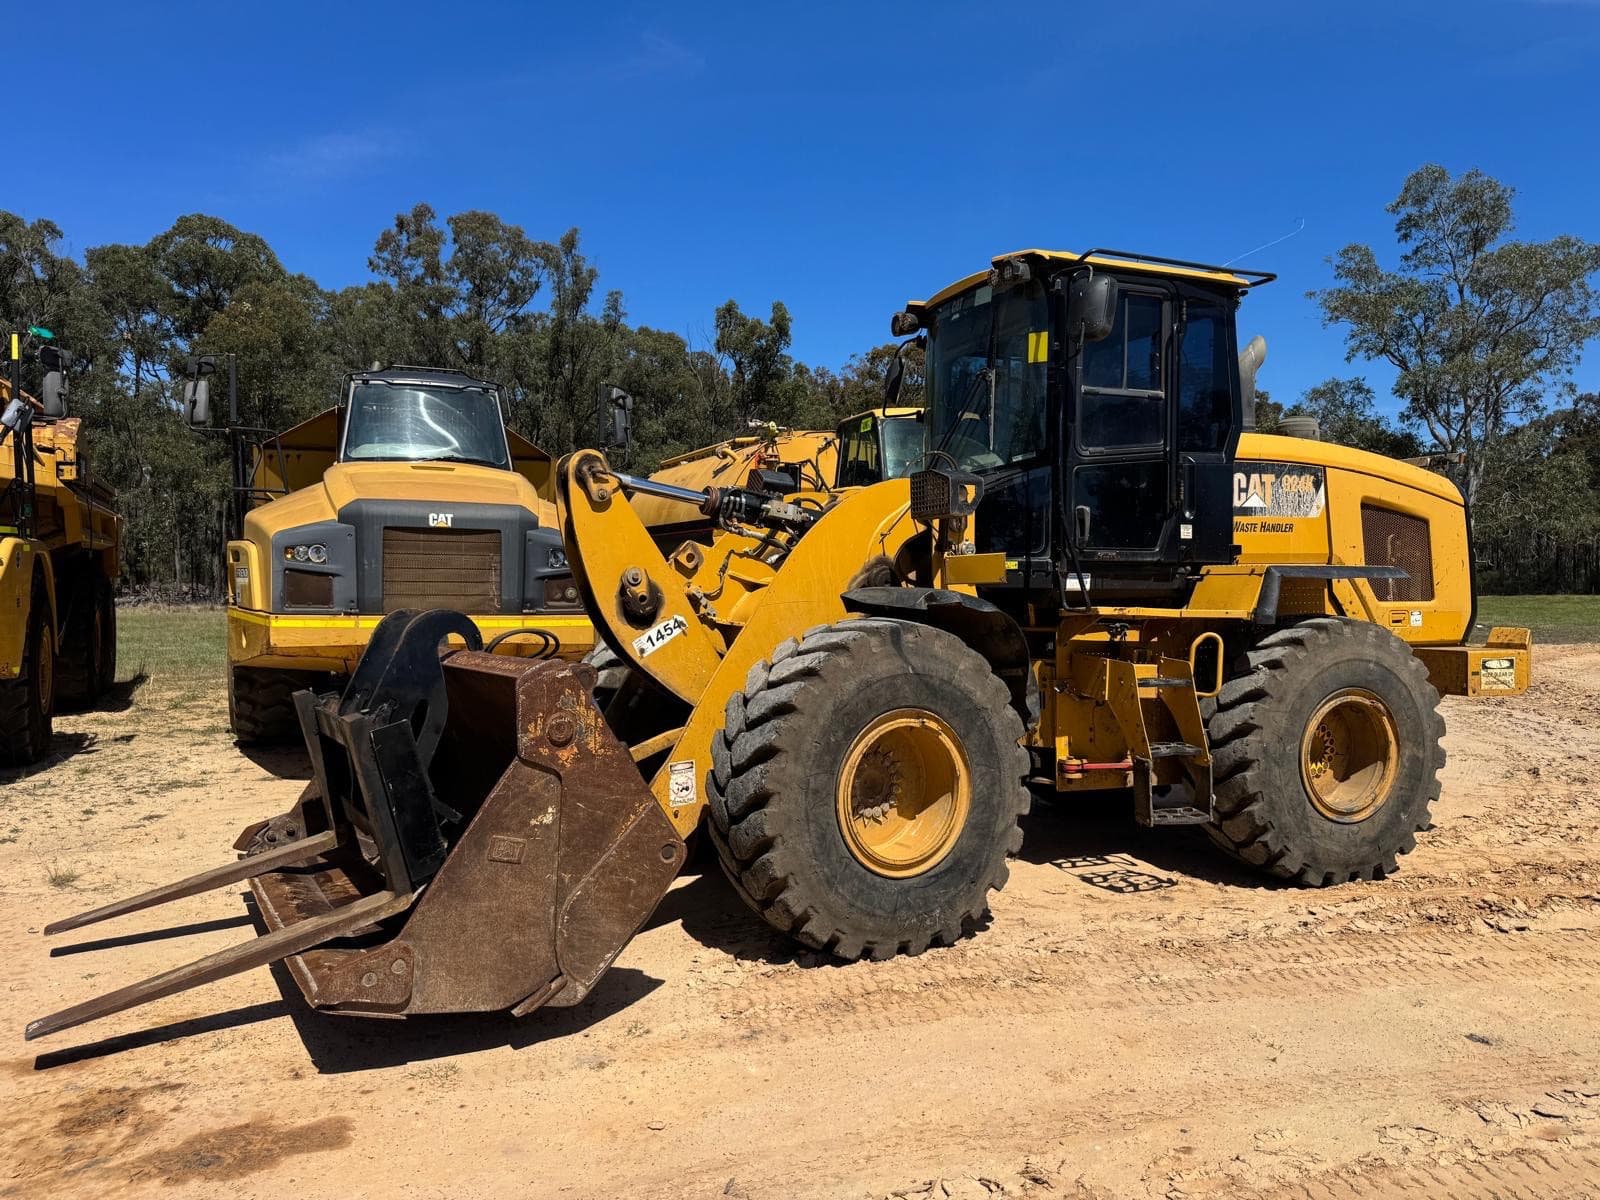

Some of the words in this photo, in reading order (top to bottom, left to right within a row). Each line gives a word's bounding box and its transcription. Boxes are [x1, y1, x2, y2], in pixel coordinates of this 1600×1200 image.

[1233, 472, 1275, 507] CAT
[428, 513, 454, 527] CAT
[1233, 521, 1259, 532] WASTE
[1260, 521, 1294, 533] HANDLER
[646, 618, 681, 647] 1454
[492, 840, 525, 860] CAT
